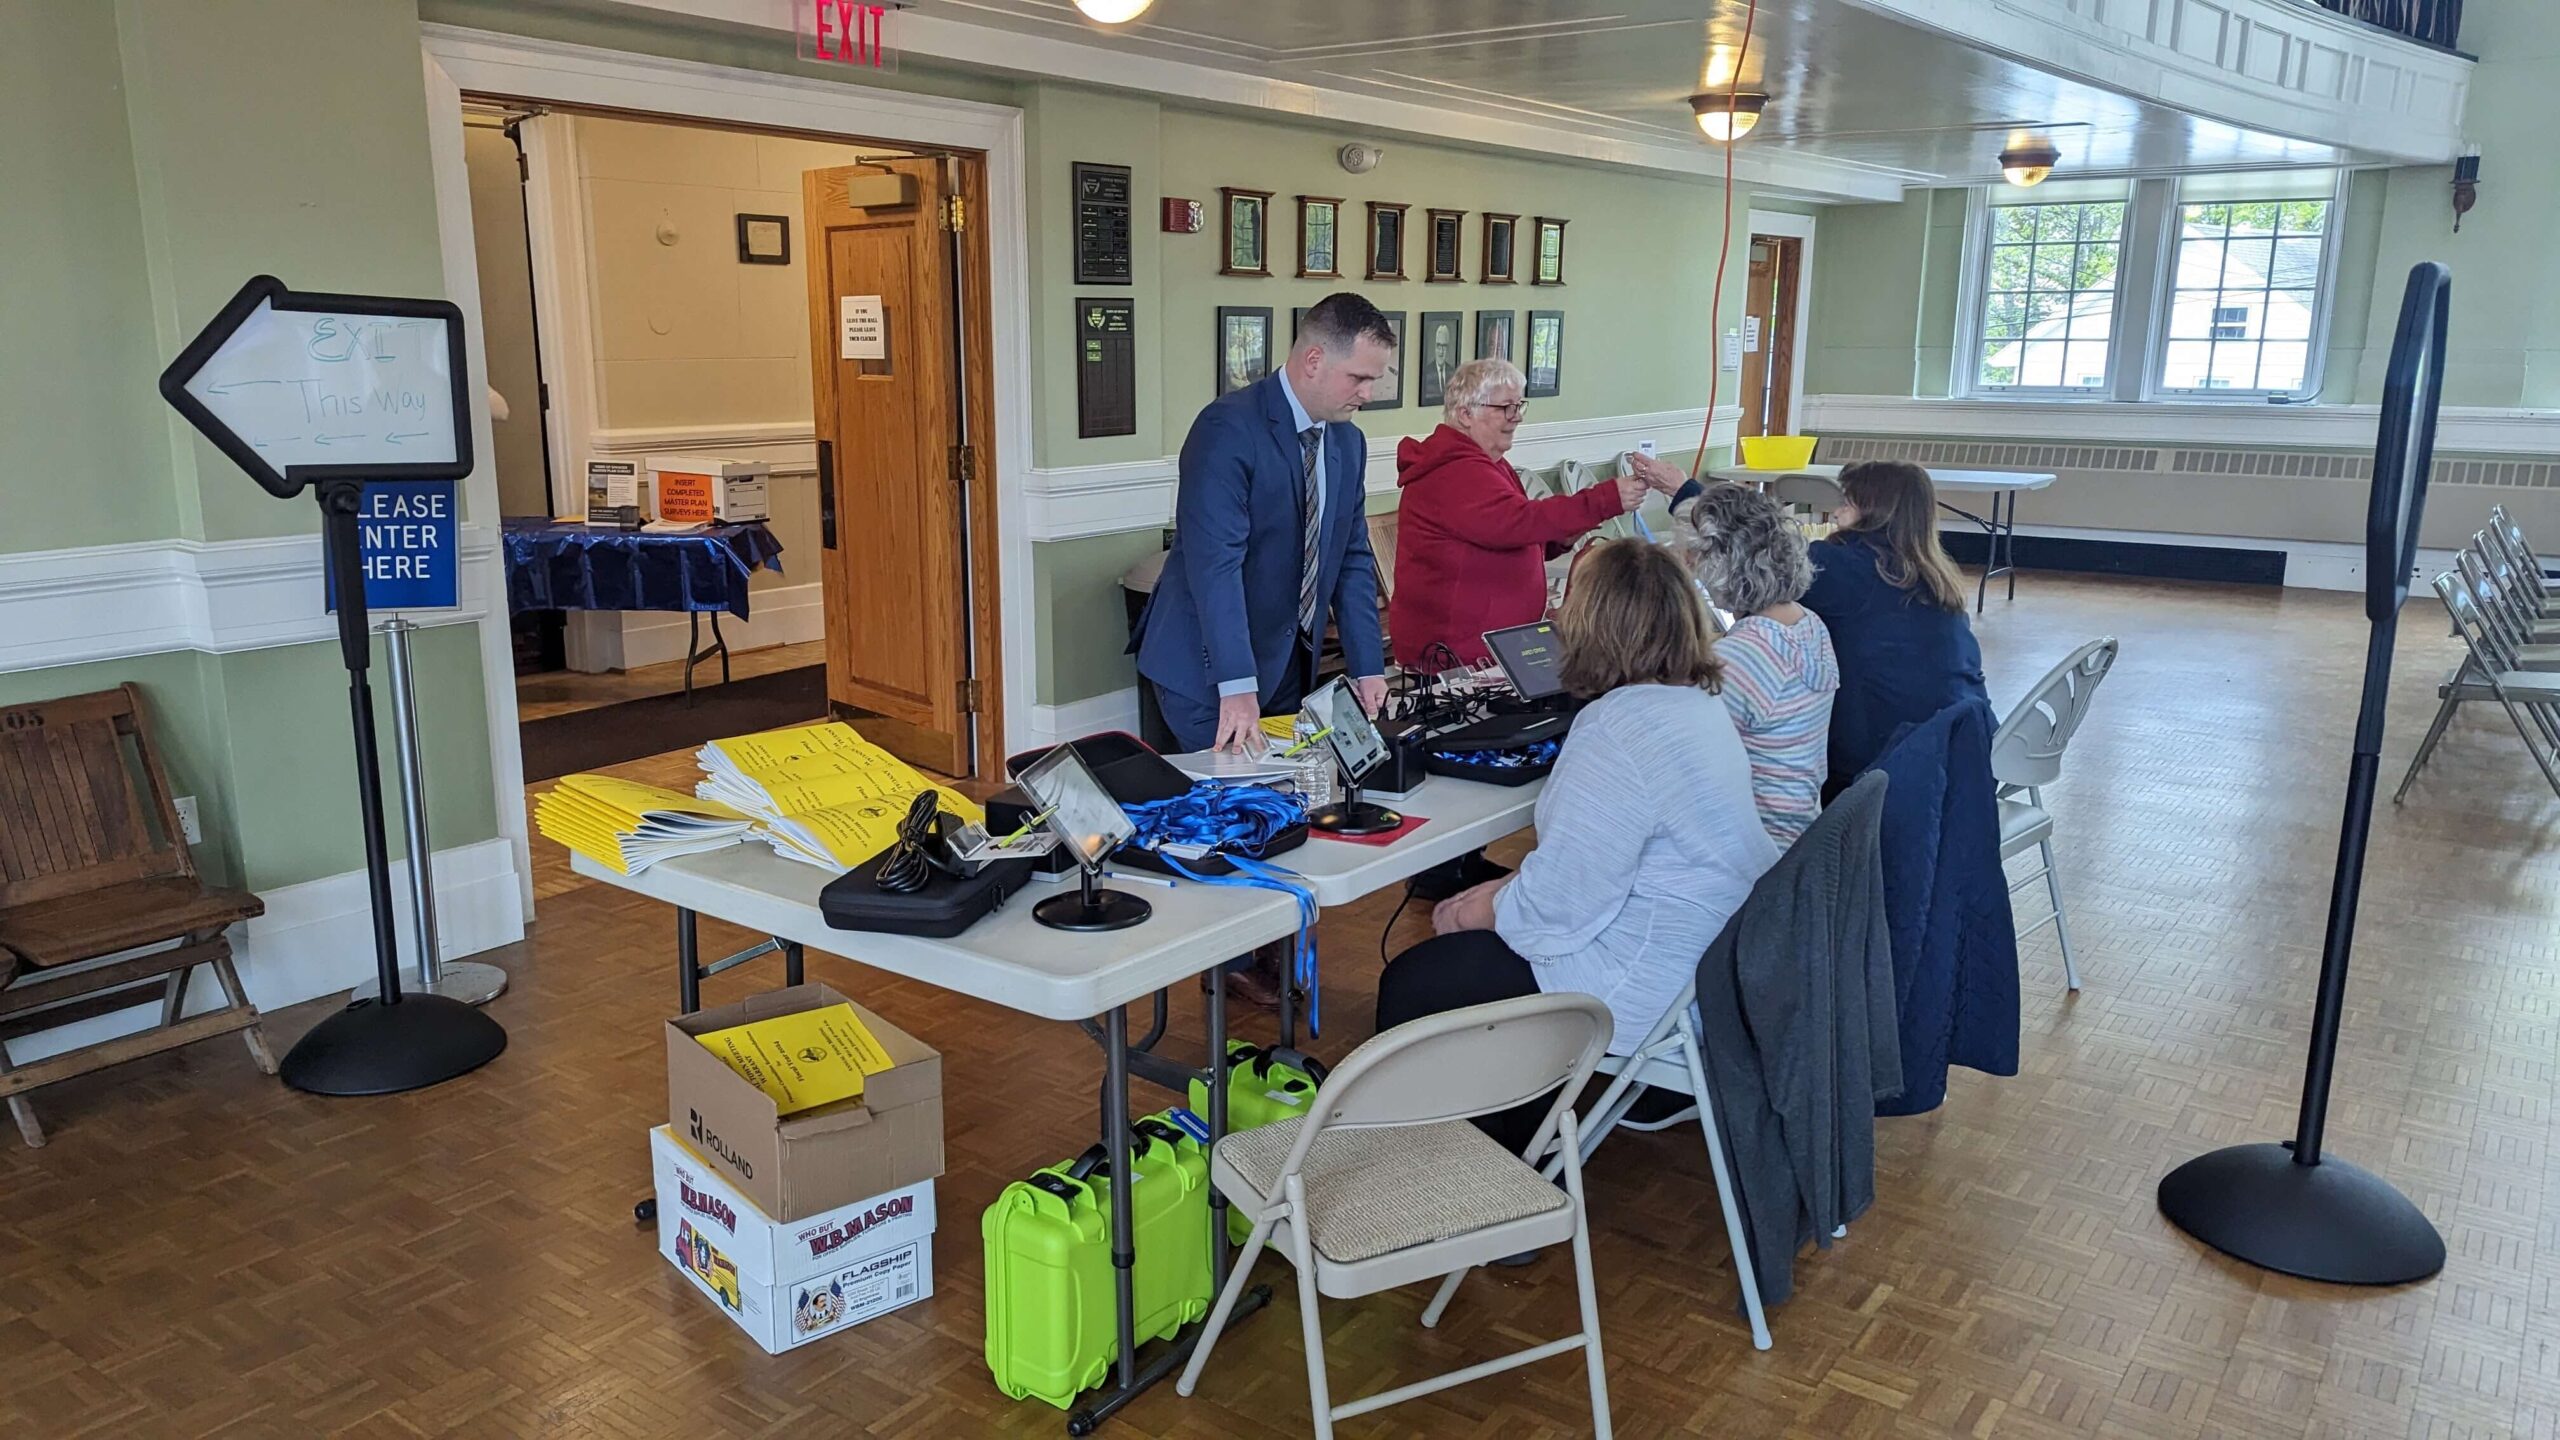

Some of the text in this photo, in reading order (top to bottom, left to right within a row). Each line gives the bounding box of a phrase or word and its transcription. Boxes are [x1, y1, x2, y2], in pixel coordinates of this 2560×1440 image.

[816, 0, 885, 68] EXIT
[307, 317, 427, 362] EXIT
[286, 378, 426, 423] This Way
[664, 498, 708, 507] MASTER PLAN
[666, 488, 705, 497] COMPLETED
[357, 494, 447, 518] EASE
[664, 507, 709, 517] SURVEYS HERE
[358, 525, 438, 549] NTER
[706, 1128, 753, 1180] ROLLAND
[798, 1222, 834, 1241] WHO BUT
[842, 1250, 912, 1281] FLAGSHIP
[842, 1274, 873, 1288] Premium
[874, 1268, 891, 1278] Copy
[892, 1260, 912, 1271] Paper
